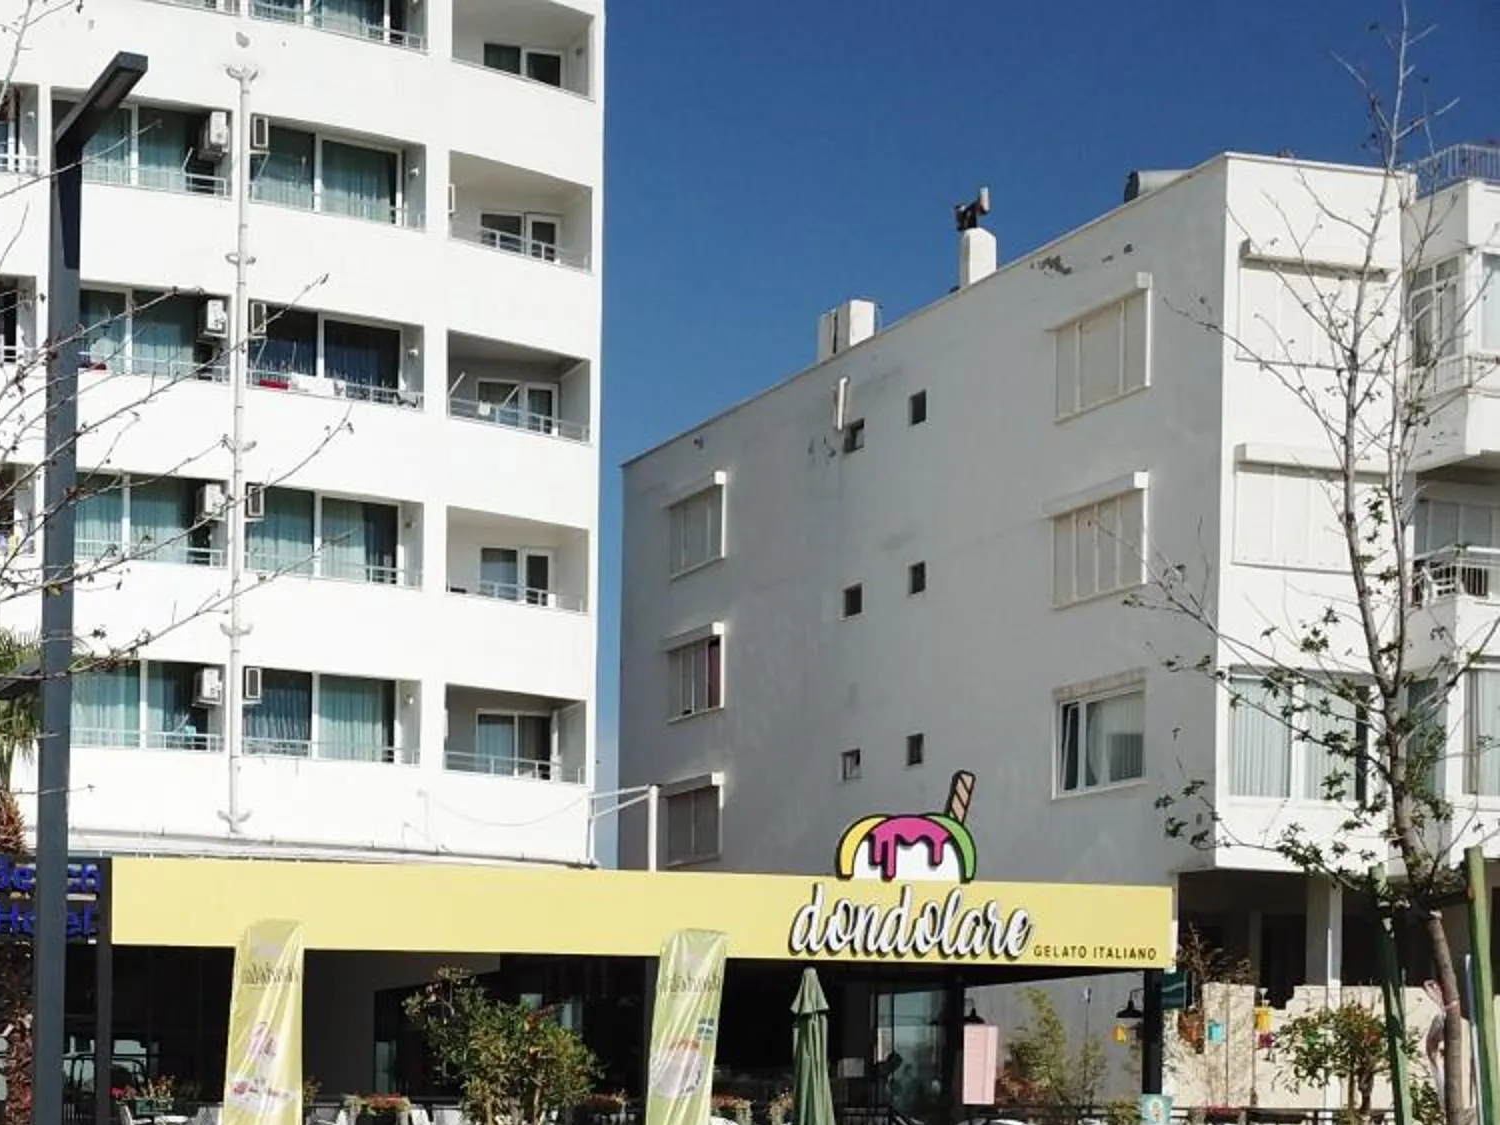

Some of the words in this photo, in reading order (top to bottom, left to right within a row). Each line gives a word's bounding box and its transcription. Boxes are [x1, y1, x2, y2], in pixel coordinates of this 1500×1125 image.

[788, 882, 1034, 960] dondolare
[1033, 944, 1088, 960] GELATO
[1092, 945, 1158, 961] ITALIANO
